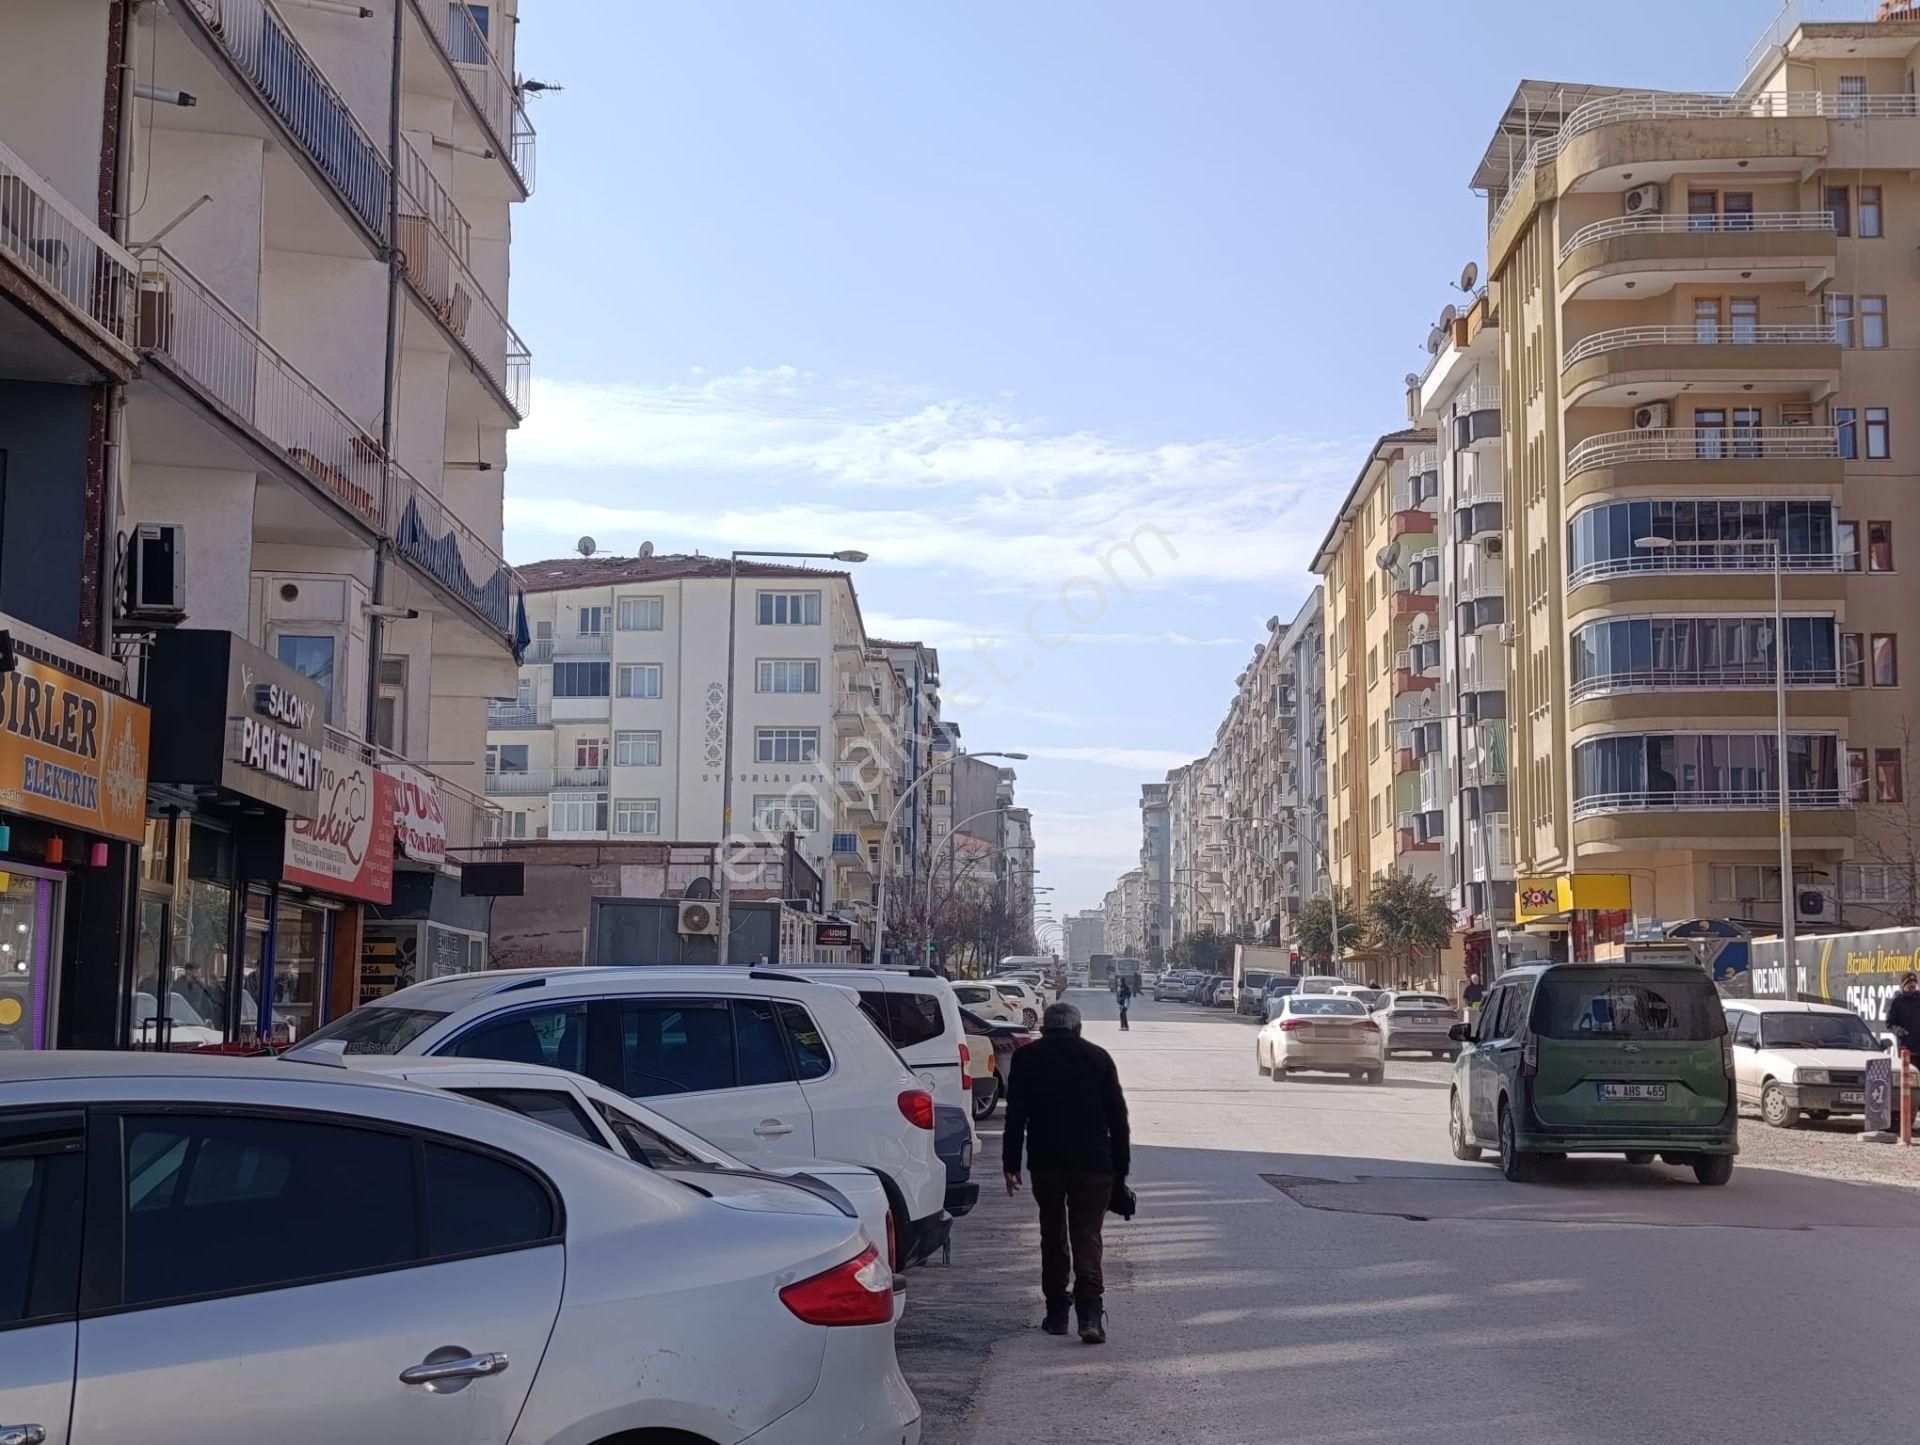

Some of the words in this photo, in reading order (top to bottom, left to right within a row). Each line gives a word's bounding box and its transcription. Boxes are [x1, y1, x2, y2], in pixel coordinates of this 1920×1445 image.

[268, 684, 304, 728] SALON
[242, 717, 321, 791] PARLEMENT
[23, 757, 98, 809] ELEKTRİK
[702, 774, 791, 783] UYUNLAR
[1522, 889, 1556, 909] ŞOK
[361, 965, 380, 975] RSA
